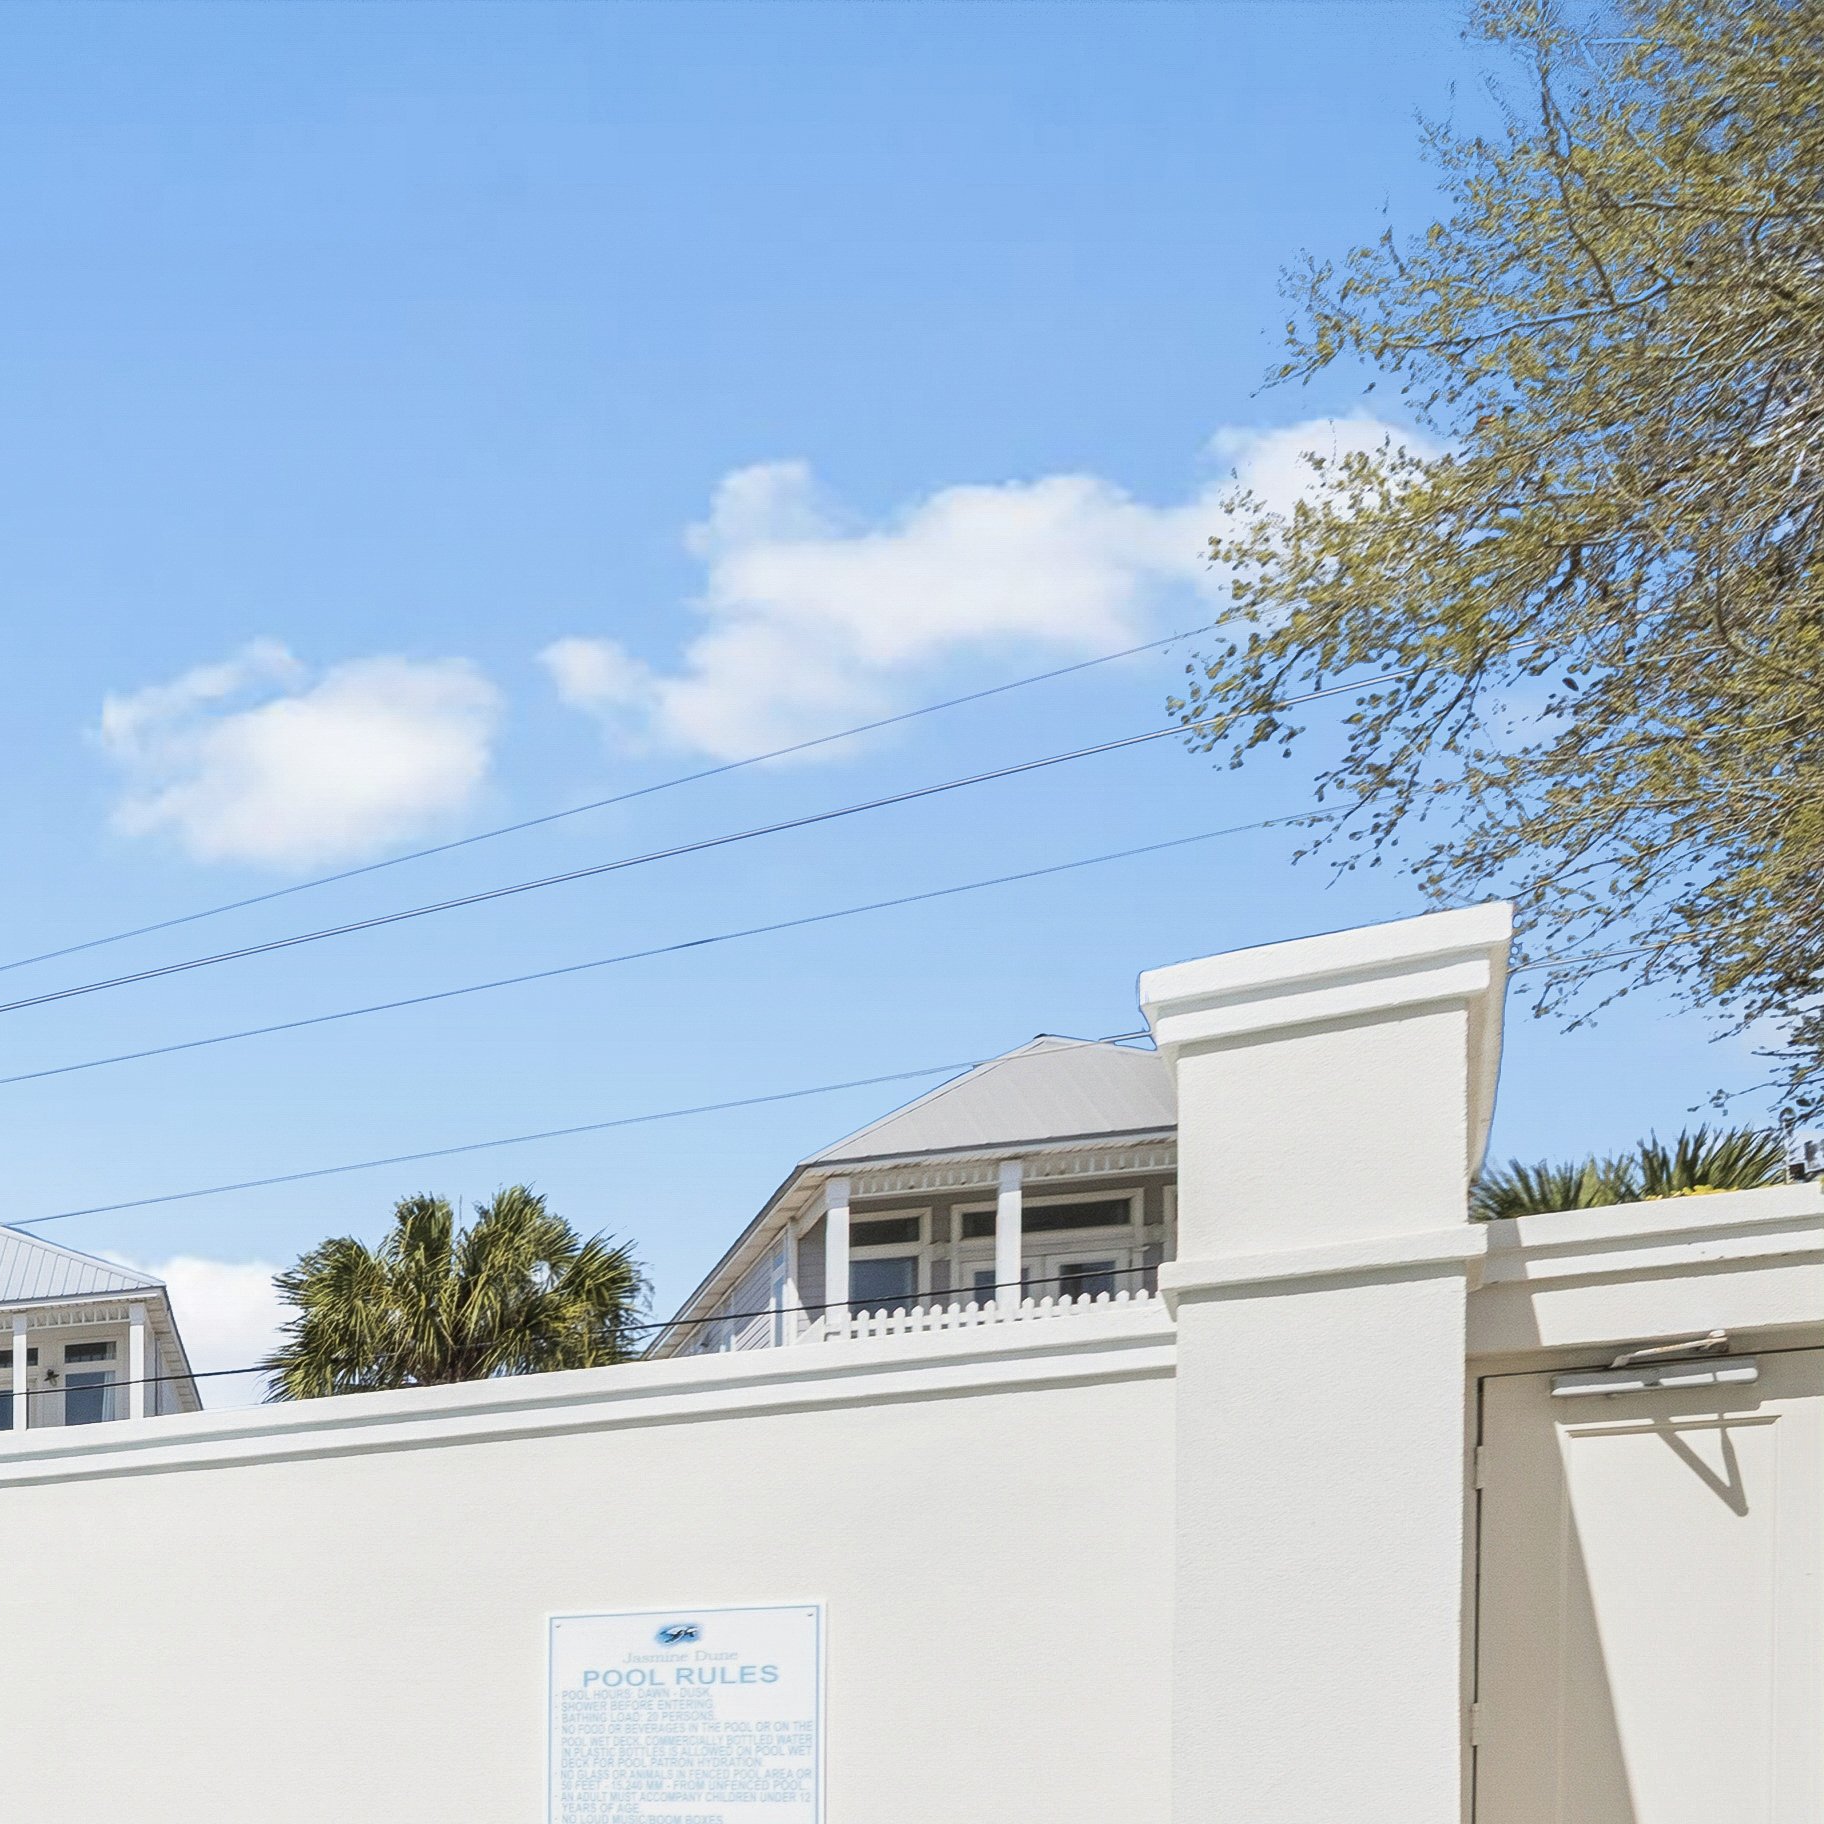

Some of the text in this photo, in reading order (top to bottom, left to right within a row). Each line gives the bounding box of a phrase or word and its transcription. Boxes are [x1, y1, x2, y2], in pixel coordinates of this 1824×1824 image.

[622, 1648, 738, 1664] Jasmine Dune
[583, 1663, 778, 1687] POOL RULES
[561, 1689, 590, 1701] POOL
[638, 1687, 670, 1699] DAWN
[560, 1700, 607, 1712] SHOWER
[610, 1699, 654, 1711] BEFORE
[561, 1712, 607, 1723] BATHING
[646, 1710, 658, 1722] 20
[560, 1719, 813, 1735] NO FOOD OR BEVERAGES IN THE POOL OR ON THE
[561, 1735, 587, 1747] POOL
[590, 1735, 610, 1746] WET
[645, 1734, 723, 1746] COMMERCIALLY
[726, 1733, 773, 1745] BOTTLED
[775, 1732, 812, 1744] WATER
[574, 1746, 615, 1757] PLASTIC
[618, 1745, 665, 1757] BOTTLES
[680, 1745, 732, 1757] ALLOWED
[735, 1744, 752, 1756] ON
[754, 1744, 785, 1756] POOL
[787, 1744, 812, 1756] WET
[561, 1757, 589, 1768] DECK
[593, 1757, 614, 1768] FOR
[617, 1757, 647, 1768] POOL
[650, 1756, 693, 1768] PATRON
[560, 1769, 574, 1780] NO
[576, 1768, 609, 1779] GLASS
[612, 1768, 626, 1779] OR
[629, 1768, 673, 1779] ANIMALS
[688, 1768, 730, 1779] FENCED
[732, 1768, 760, 1779] POOL
[764, 1767, 793, 1779] AREA
[795, 1767, 812, 1779] OR
[575, 1779, 601, 1790] FEET
[673, 1779, 704, 1790] FROM
[708, 1779, 769, 1790] UNFENCED
[560, 1791, 574, 1802] AN
[576, 1791, 607, 1802] ADULT
[609, 1791, 637, 1802] MUST
[639, 1791, 702, 1802] ACCOMPANY
[705, 1791, 756, 1802] CHILDREN
[759, 1791, 796, 1802] UNDER
[561, 1802, 597, 1813] YEARS
[599, 1802, 614, 1813] OF
[561, 1813, 576, 1824] NO
[579, 1813, 609, 1824] LOUD
